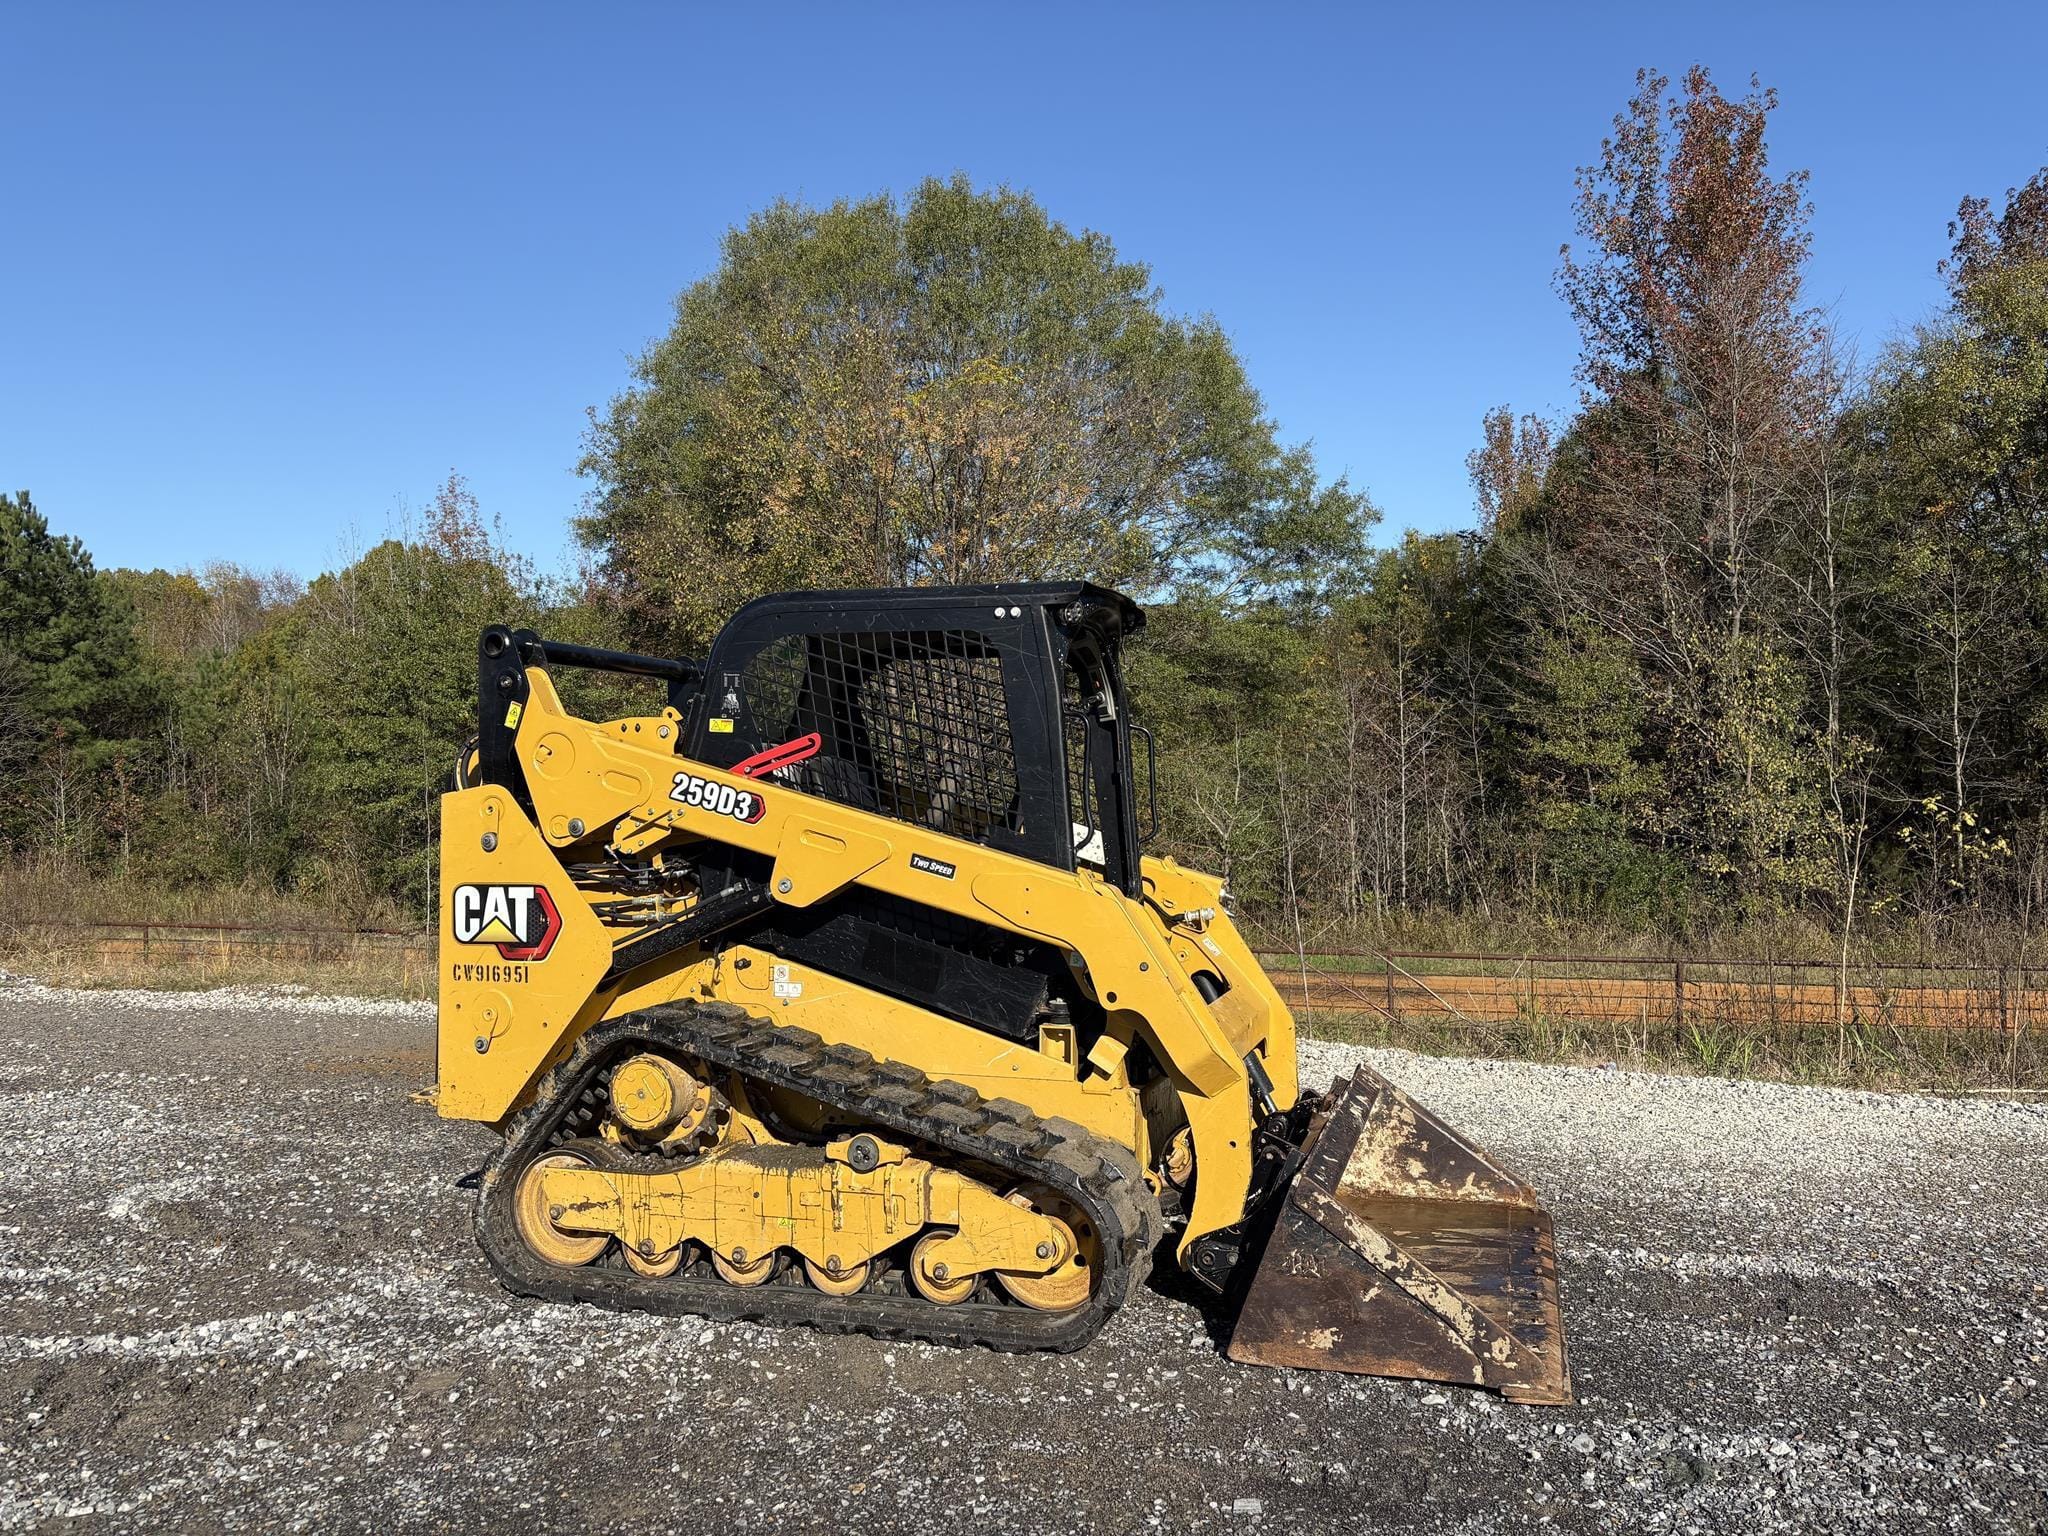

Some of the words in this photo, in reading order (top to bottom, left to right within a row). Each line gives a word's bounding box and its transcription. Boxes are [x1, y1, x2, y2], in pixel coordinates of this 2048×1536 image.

[670, 773, 752, 820] 259D3
[454, 885, 534, 943] CAT
[453, 964, 529, 983] CW916951
